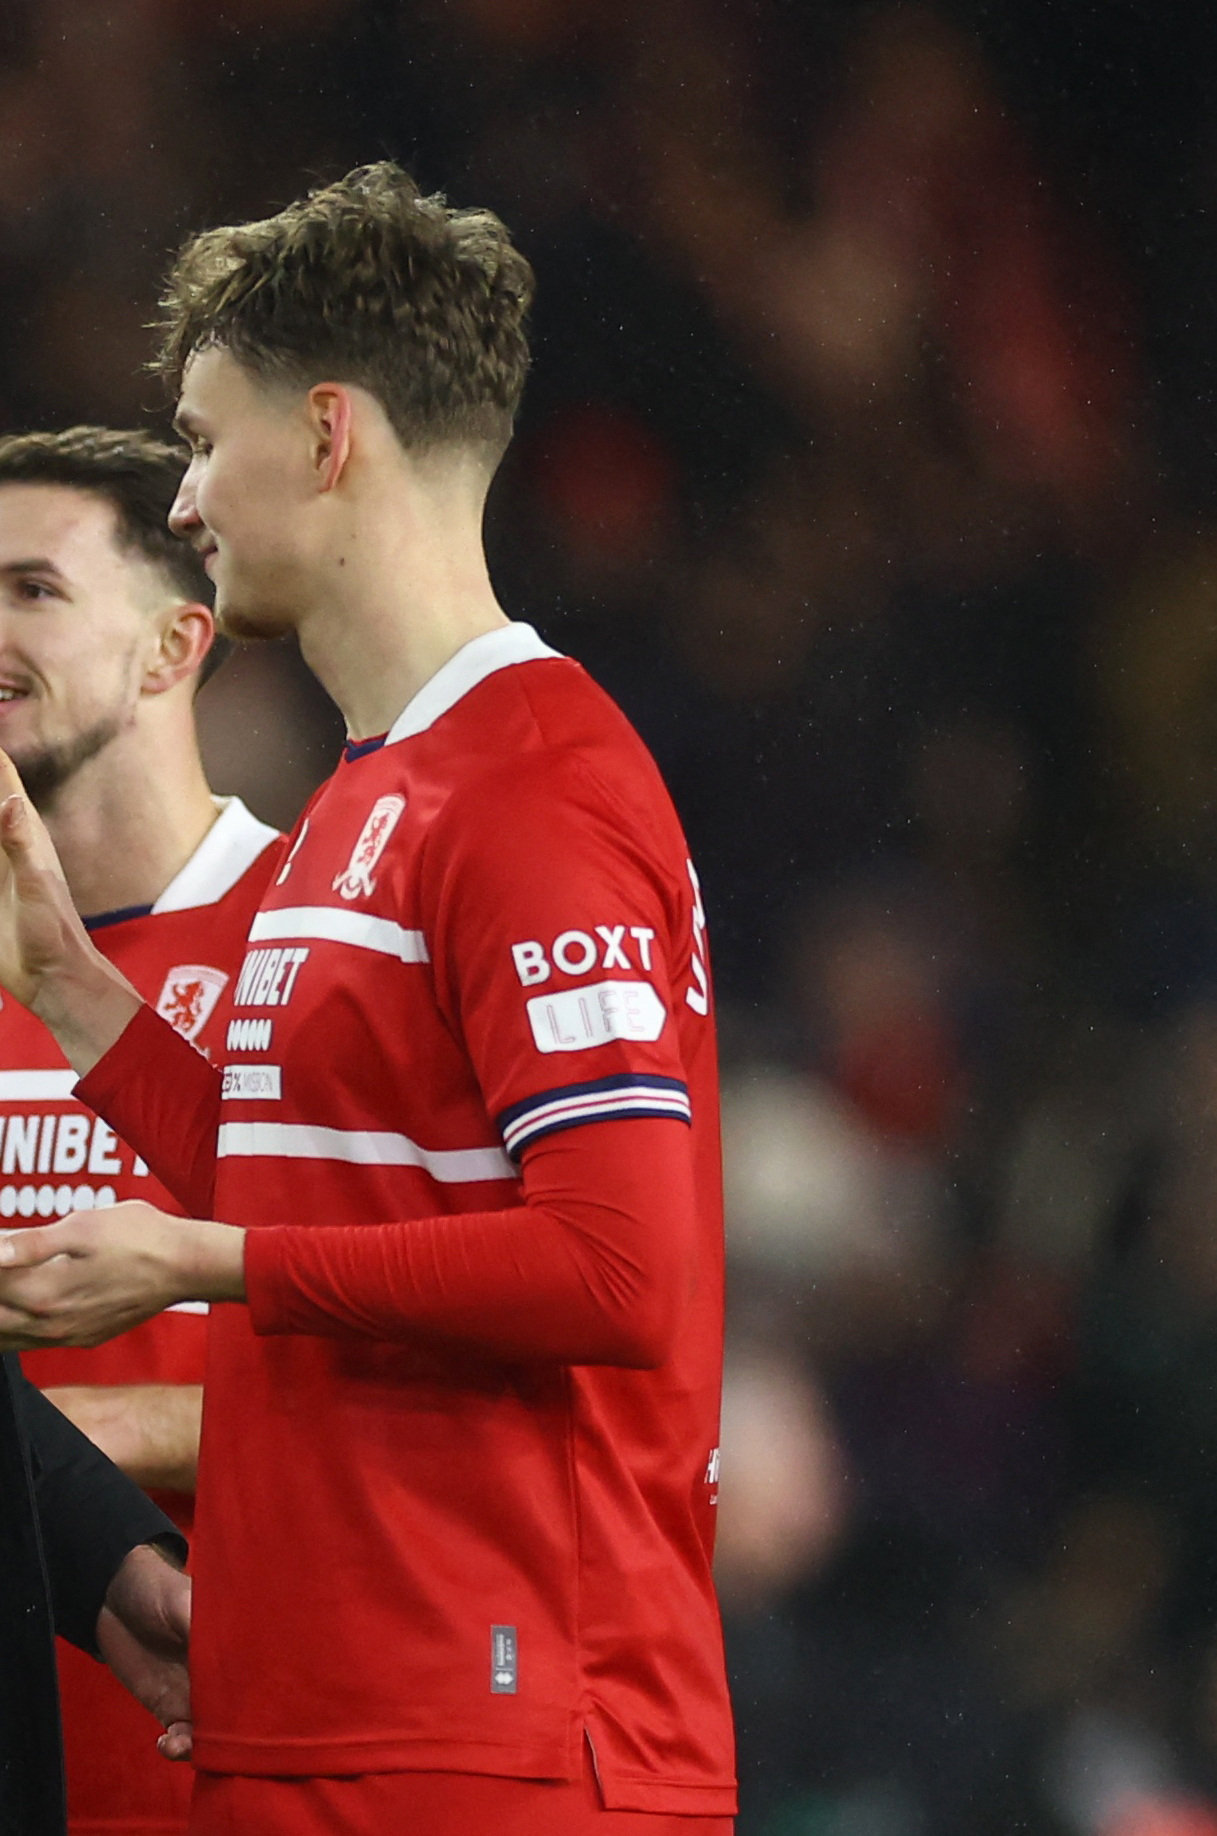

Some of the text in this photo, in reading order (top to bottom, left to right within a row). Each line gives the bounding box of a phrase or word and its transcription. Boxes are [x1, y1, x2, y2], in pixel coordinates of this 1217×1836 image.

[233, 947, 310, 1006] NIBET
[511, 924, 655, 987] BOXT
[547, 989, 645, 1045] LIFE
